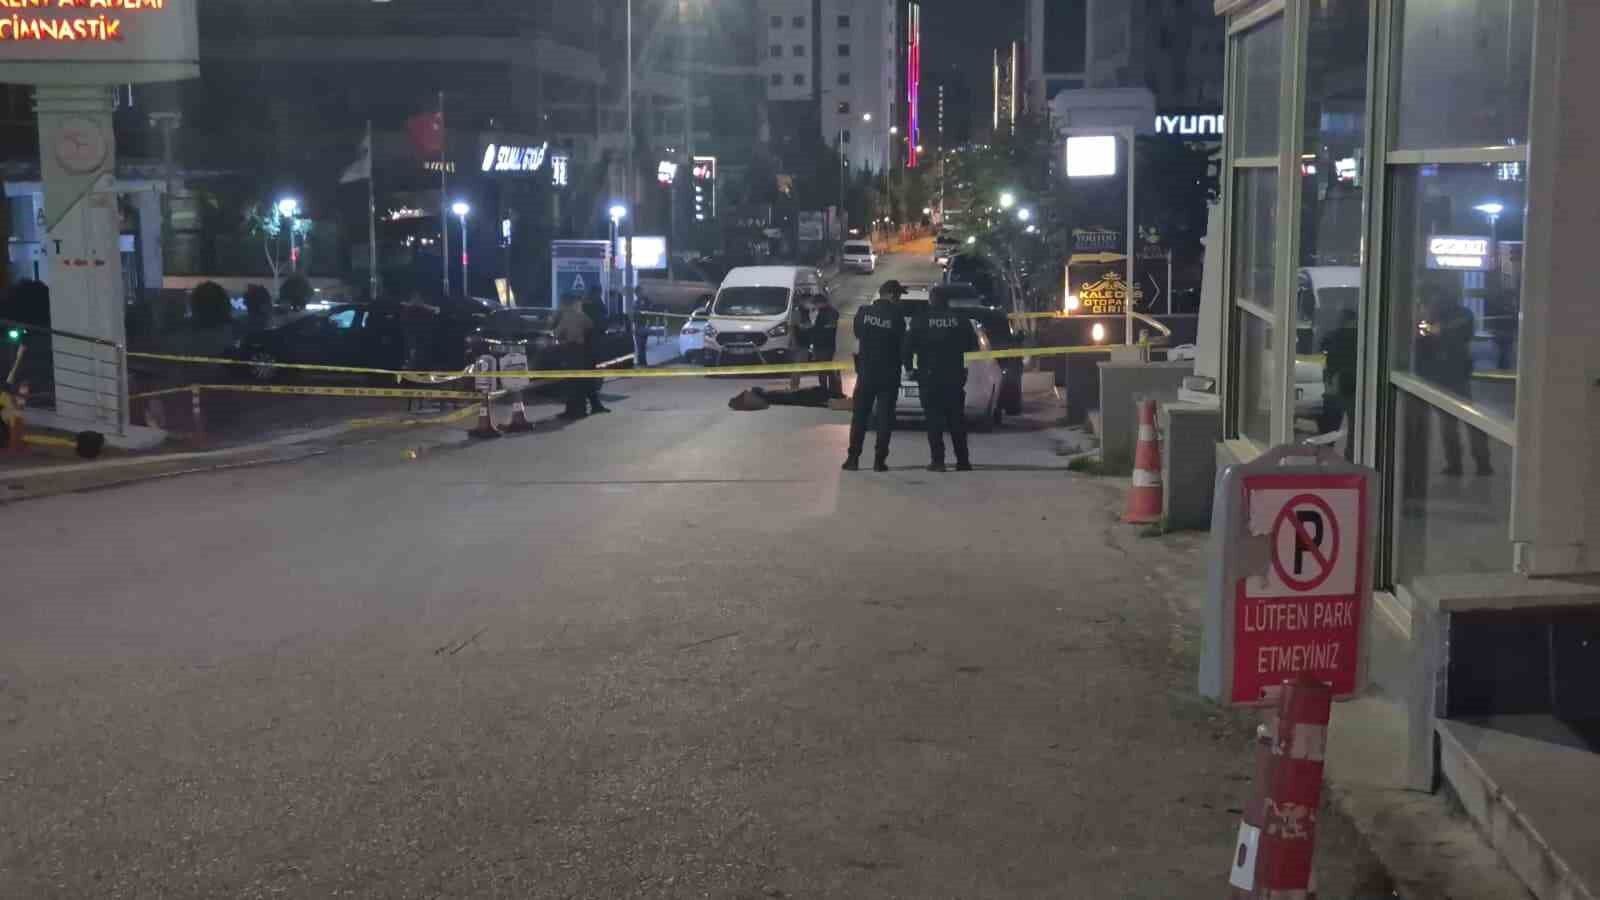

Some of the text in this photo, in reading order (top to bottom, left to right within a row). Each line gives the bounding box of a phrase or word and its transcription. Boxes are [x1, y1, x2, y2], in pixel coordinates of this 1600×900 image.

[1245, 601, 1353, 631] LÜTFEN PARK
[1258, 640, 1340, 673] ETMEYİNİZ
